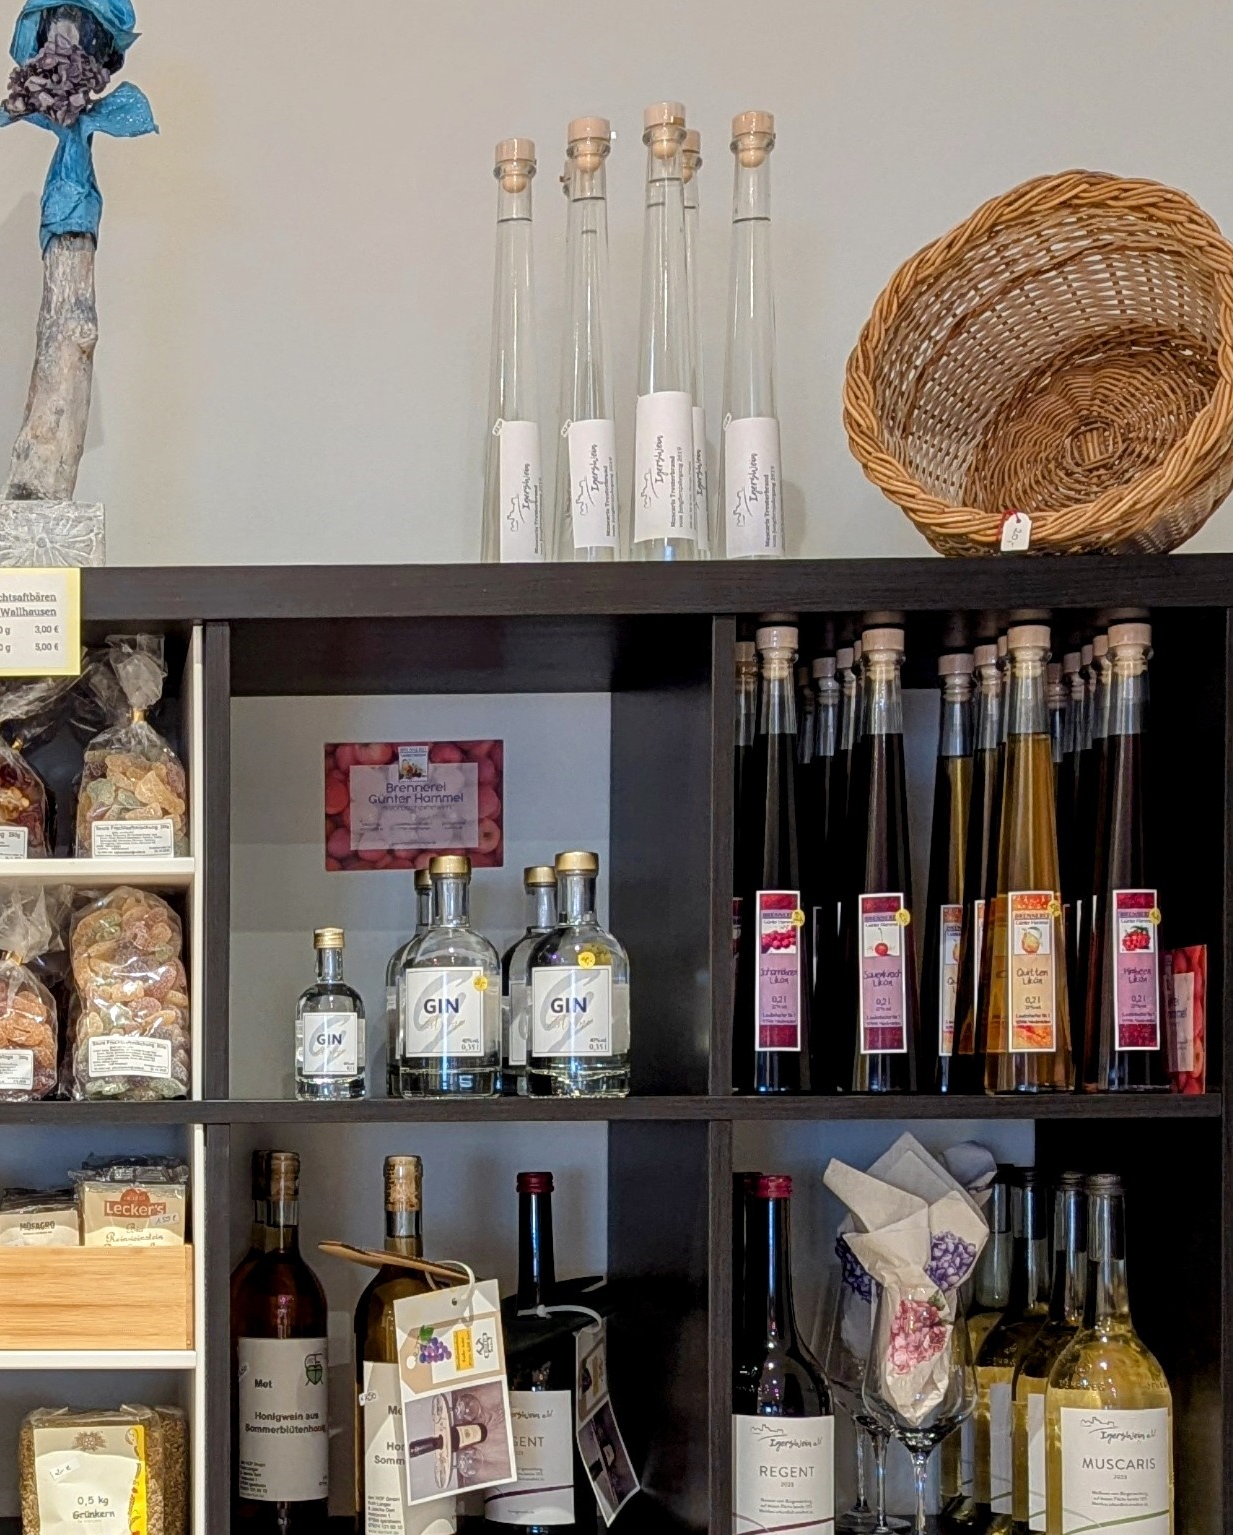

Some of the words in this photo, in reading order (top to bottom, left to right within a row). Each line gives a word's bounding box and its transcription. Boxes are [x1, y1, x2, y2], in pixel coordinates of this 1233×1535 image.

[0, 608, 56, 617] Wallhausen
[5, 628, 10, 636] g
[35, 626, 51, 634] 3,00
[6, 645, 11, 653] g
[35, 643, 51, 652] 5,00
[54, 643, 58, 651] €
[386, 783, 446, 793] Brennerei
[369, 794, 411, 804] Günter
[415, 793, 463, 803] Hammel
[1017, 968, 1048, 977] Quitten
[424, 998, 459, 1014] GIN
[550, 997, 587, 1013] GIN
[317, 1034, 342, 1045] GIN
[106, 1202, 165, 1215] Lecker's
[255, 1379, 272, 1388] Met
[255, 1412, 303, 1421] Honigwein
[1082, 1458, 1155, 1470] MUSCARIS
[760, 1466, 815, 1477] REGENT
[78, 1496, 94, 1506] 0,5
[98, 1496, 108, 1506] kg
[73, 1510, 115, 1519] Grünkern
